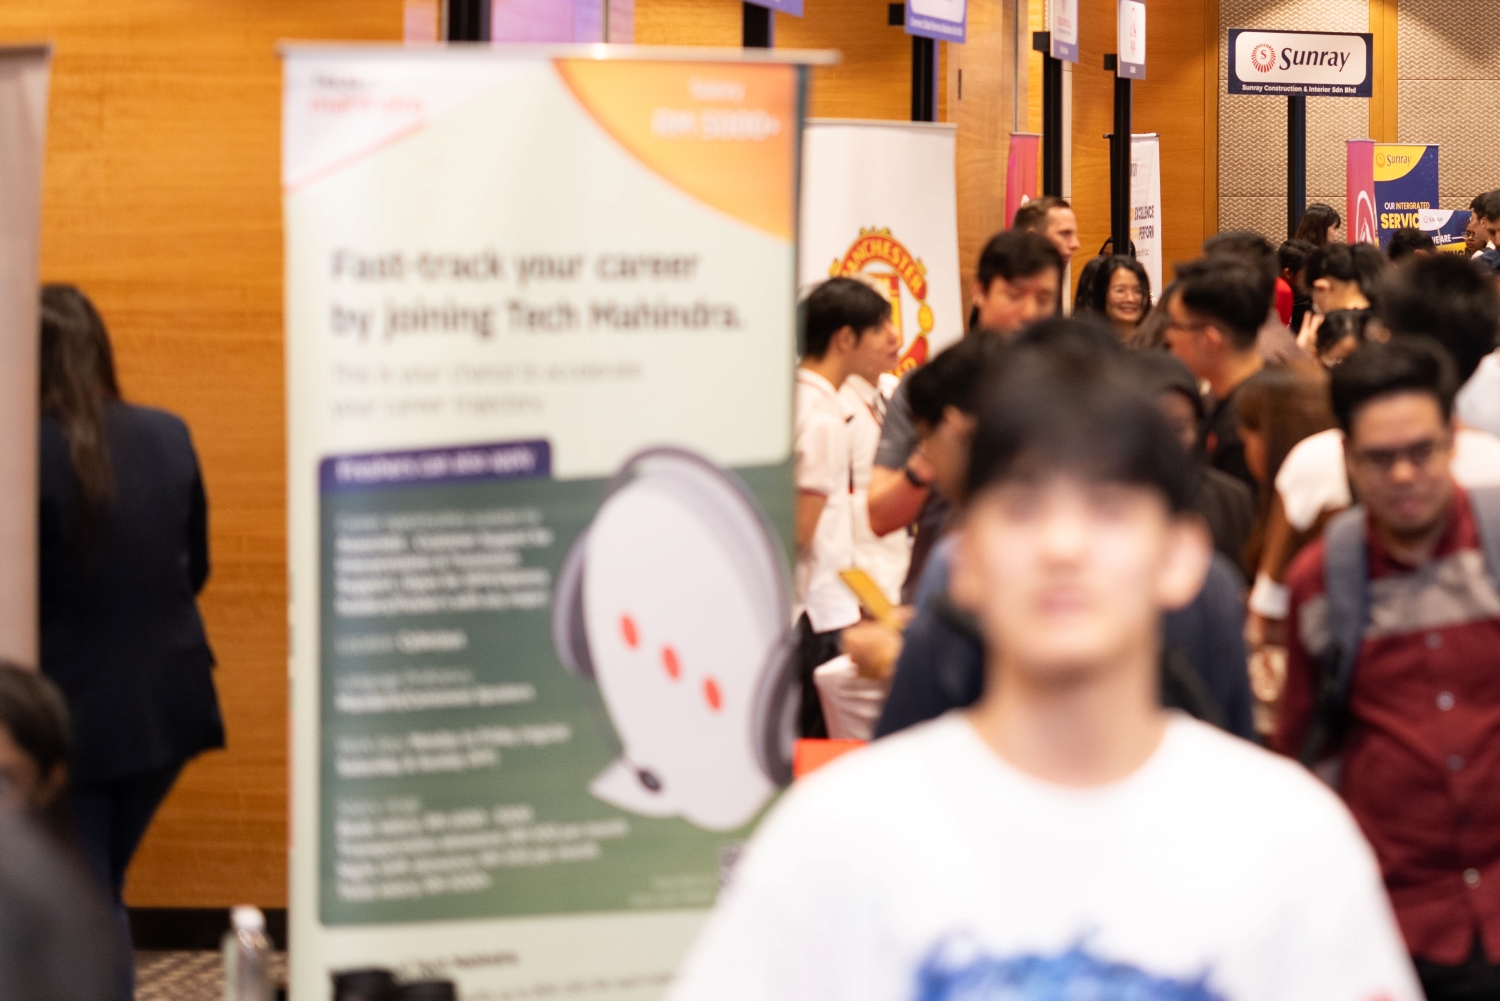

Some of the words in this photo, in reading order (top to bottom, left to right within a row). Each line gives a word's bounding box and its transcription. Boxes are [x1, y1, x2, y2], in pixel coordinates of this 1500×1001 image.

[1279, 47, 1350, 72] Sunray
[1241, 84, 1263, 92] Sunray
[1386, 154, 1412, 167] Sunray
[1384, 202, 1395, 210] OUR
[515, 254, 584, 293] your
[597, 252, 702, 281] career
[330, 300, 371, 339] by
[382, 301, 493, 341] joining
[507, 299, 577, 333] Tech
